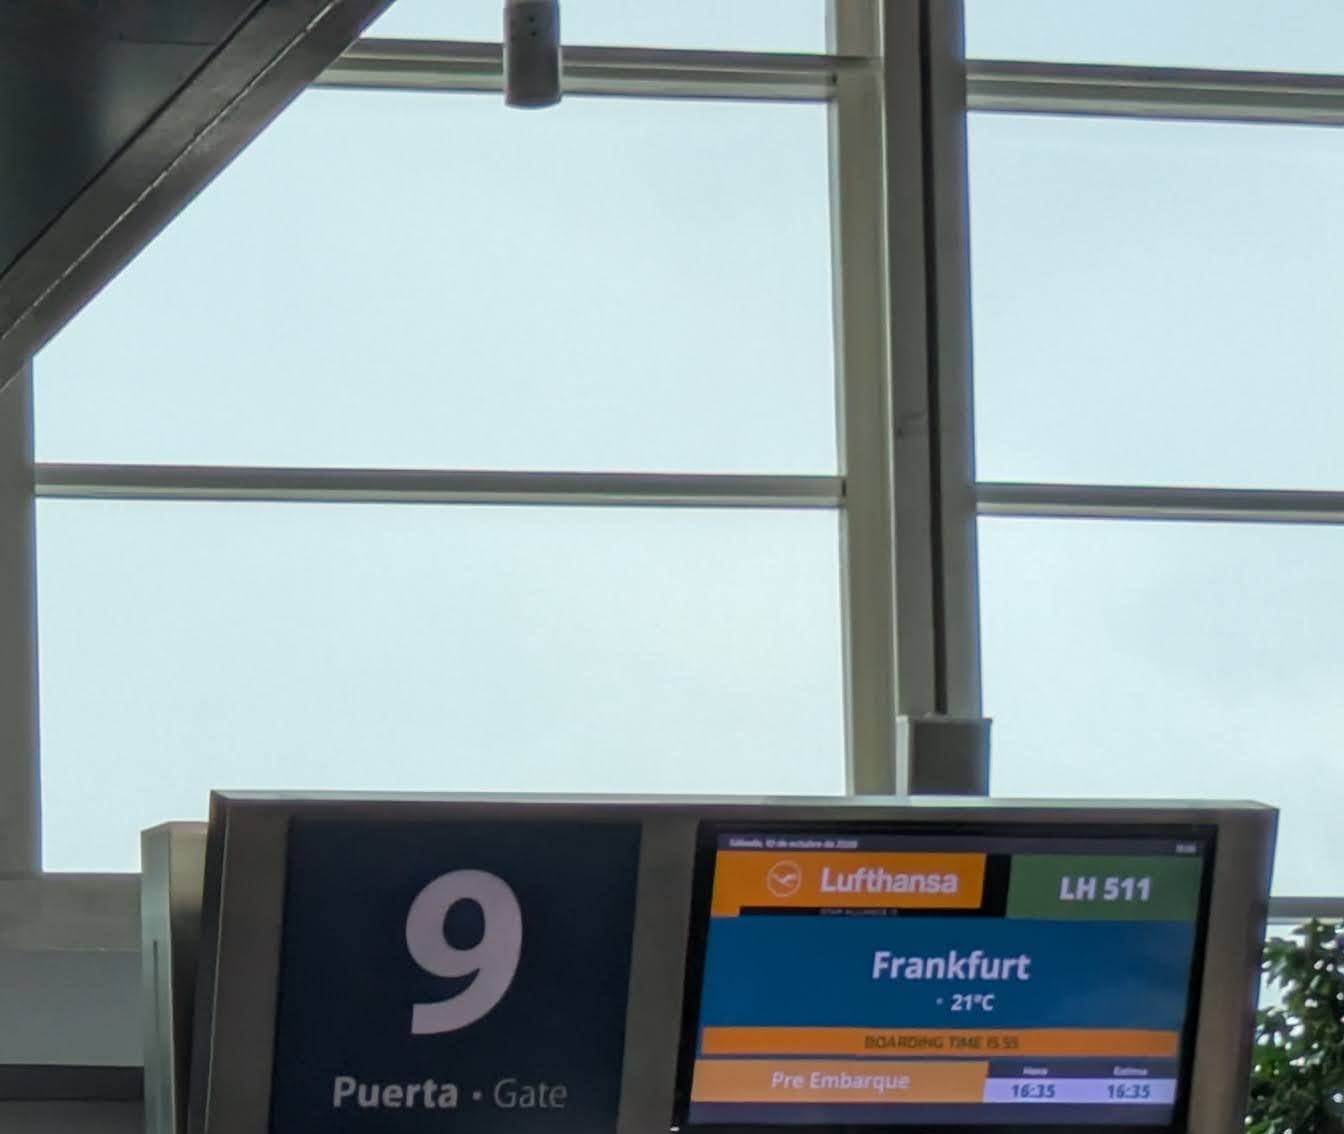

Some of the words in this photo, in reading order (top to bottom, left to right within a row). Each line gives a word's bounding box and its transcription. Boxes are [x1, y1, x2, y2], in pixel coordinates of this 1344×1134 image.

[820, 867, 959, 896] Lufthansa
[1058, 876, 1096, 901] LH
[1102, 877, 1152, 902] 511
[405, 868, 523, 1035] 9
[871, 950, 1032, 982] Frankfurt
[950, 993, 996, 1012] 21°C
[864, 1034, 944, 1051] BOARDING
[948, 1035, 983, 1051] TIME
[333, 1076, 459, 1109] Puerta
[493, 1078, 569, 1109] Gate
[771, 1071, 805, 1090] Pre
[809, 1070, 911, 1093] Embarque
[1010, 1083, 1057, 1100] 16:35
[1107, 1083, 1152, 1100] 16:35
